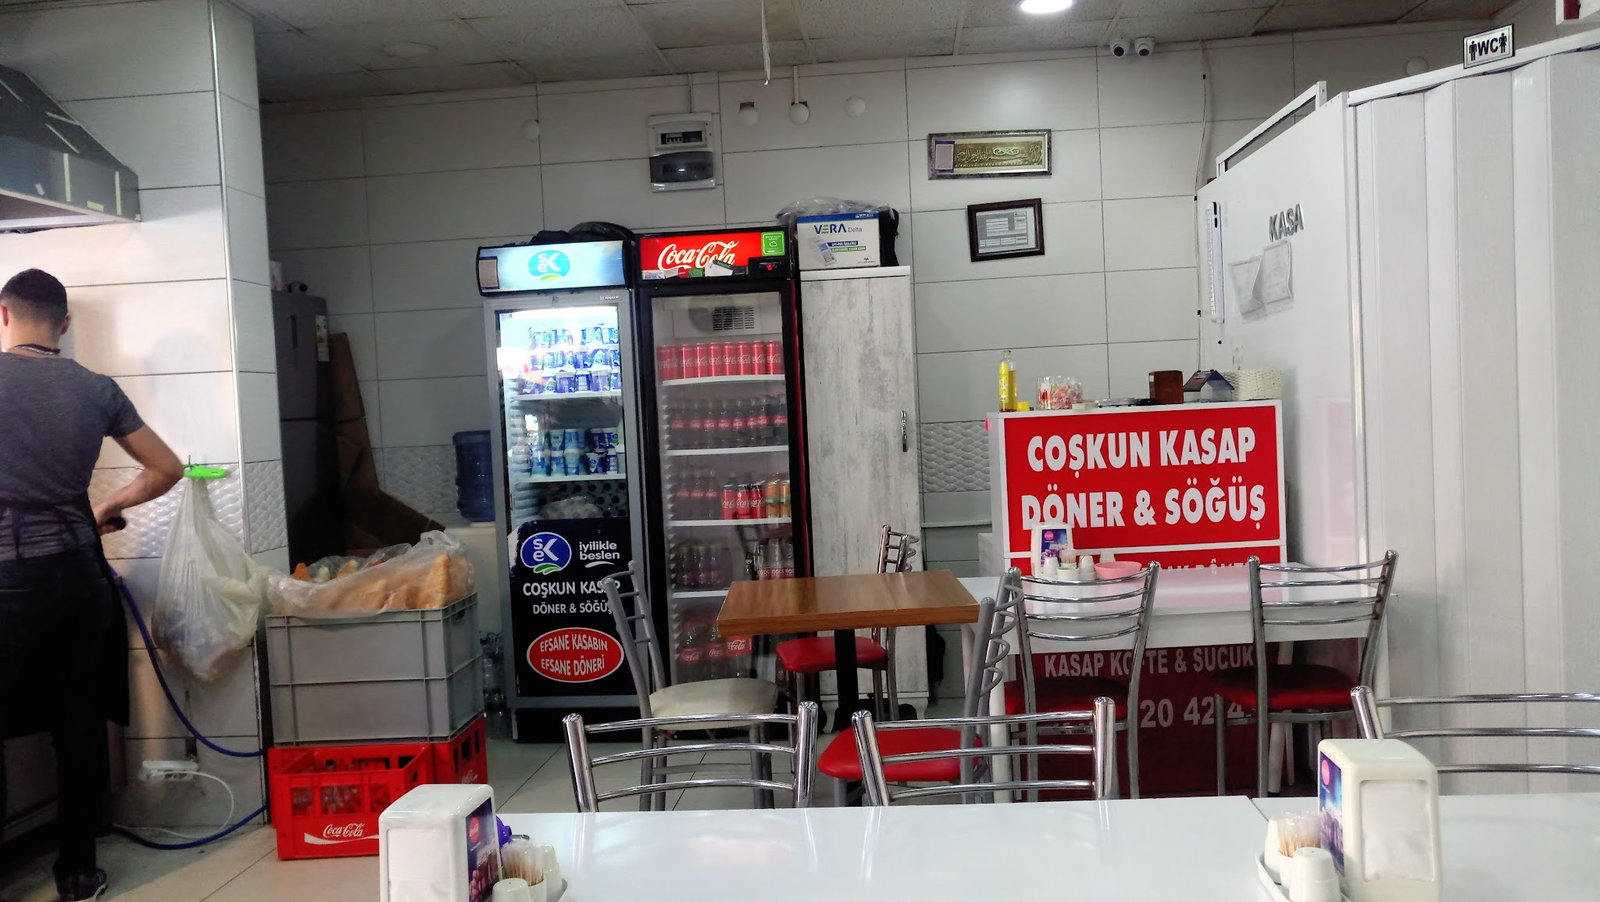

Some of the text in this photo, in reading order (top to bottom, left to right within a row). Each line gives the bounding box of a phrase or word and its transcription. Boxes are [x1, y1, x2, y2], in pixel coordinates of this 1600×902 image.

[1478, 37, 1499, 57] WC
[814, 223, 847, 234] VERA
[1269, 203, 1304, 242] KASA
[658, 240, 740, 270] Coca-Cola
[1027, 426, 1256, 478] COŞKUN KASAP
[1021, 476, 1266, 531] DÖNER & SÖĞÜŞ
[579, 540, 618, 552] iyilikle
[579, 550, 620, 561] beslen
[523, 581, 576, 598] COŞKUN
[533, 602, 567, 614] DÖNER
[569, 604, 577, 613] &
[540, 633, 608, 652] EFSANE KASABIN
[541, 654, 605, 676] EFSANE DÖNERİ
[1045, 653, 1105, 678] KASAP
[1174, 648, 1187, 673] &
[1193, 645, 1254, 672] SUCUK
[1140, 698, 1174, 728] 20
[1183, 696, 1215, 726] 42
[322, 822, 366, 838] Coca-Cola
